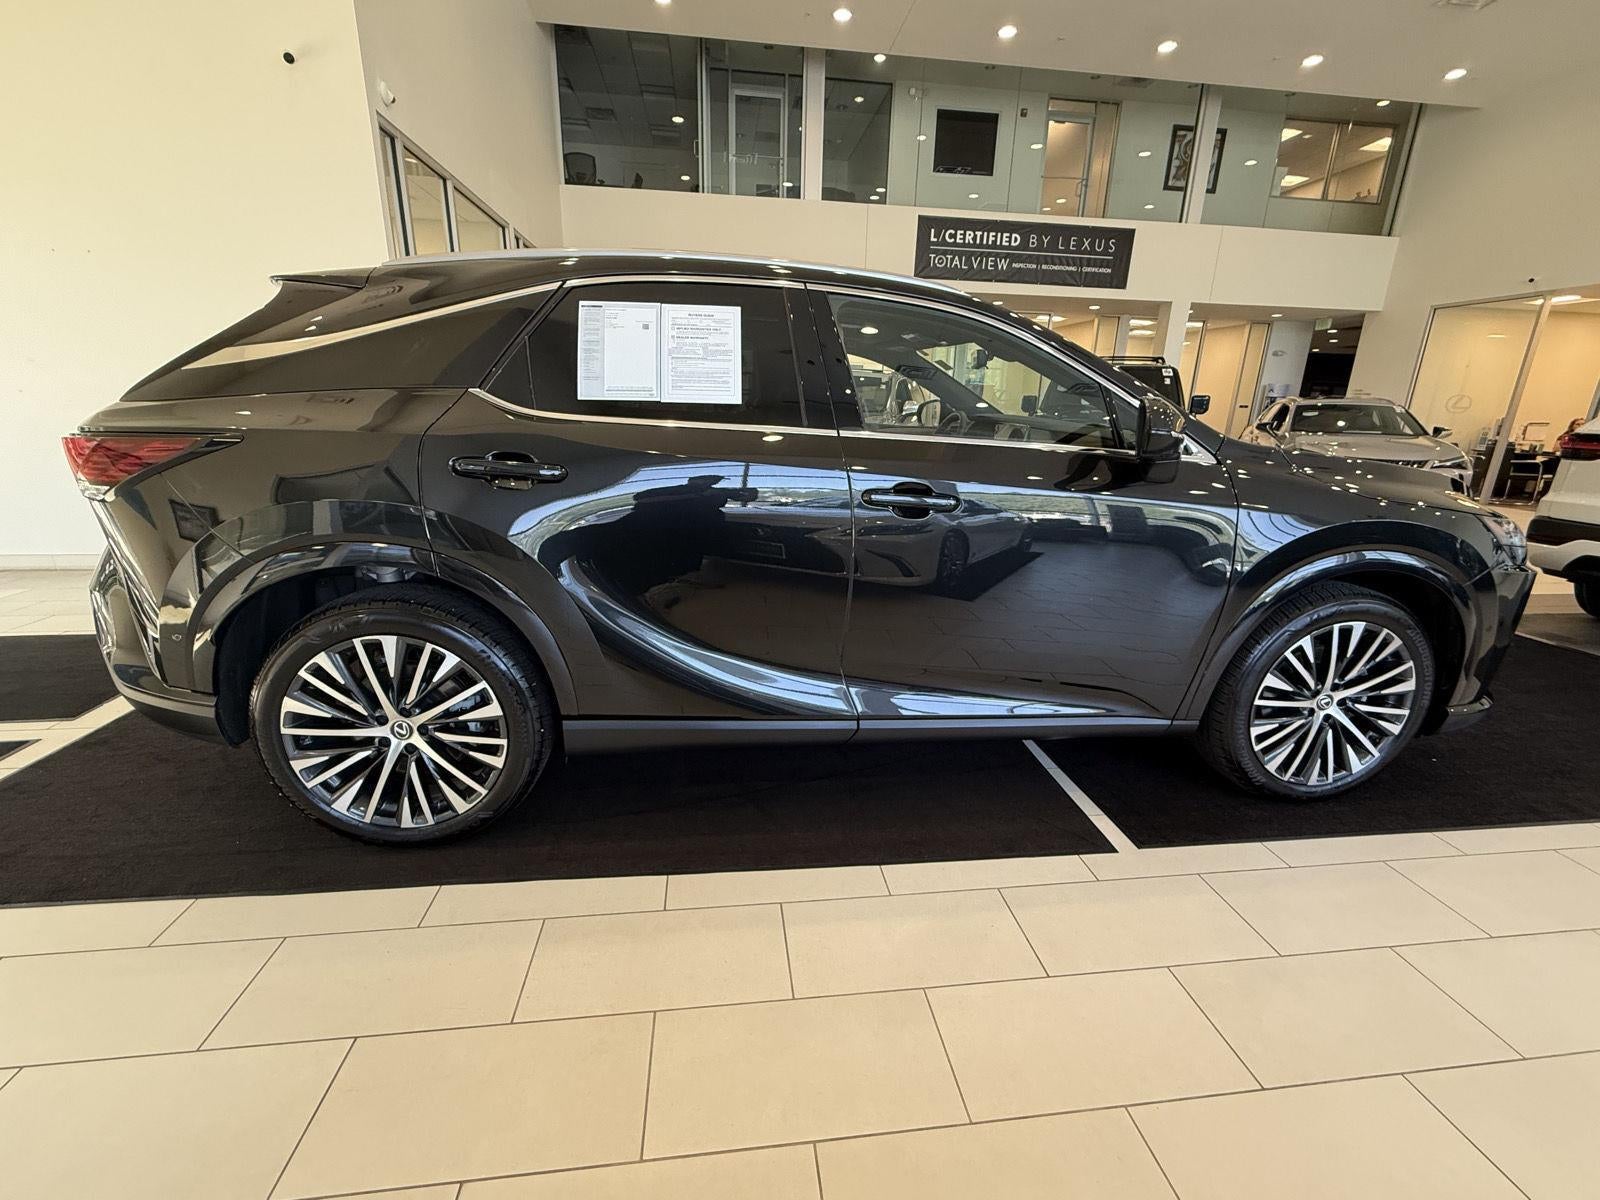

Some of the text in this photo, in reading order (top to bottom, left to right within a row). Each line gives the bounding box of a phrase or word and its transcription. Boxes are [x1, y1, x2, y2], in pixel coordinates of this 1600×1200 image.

[930, 228, 1116, 253] L/CERTIFIED BY LEXUS
[929, 254, 1010, 271] TOTAL VIEW
